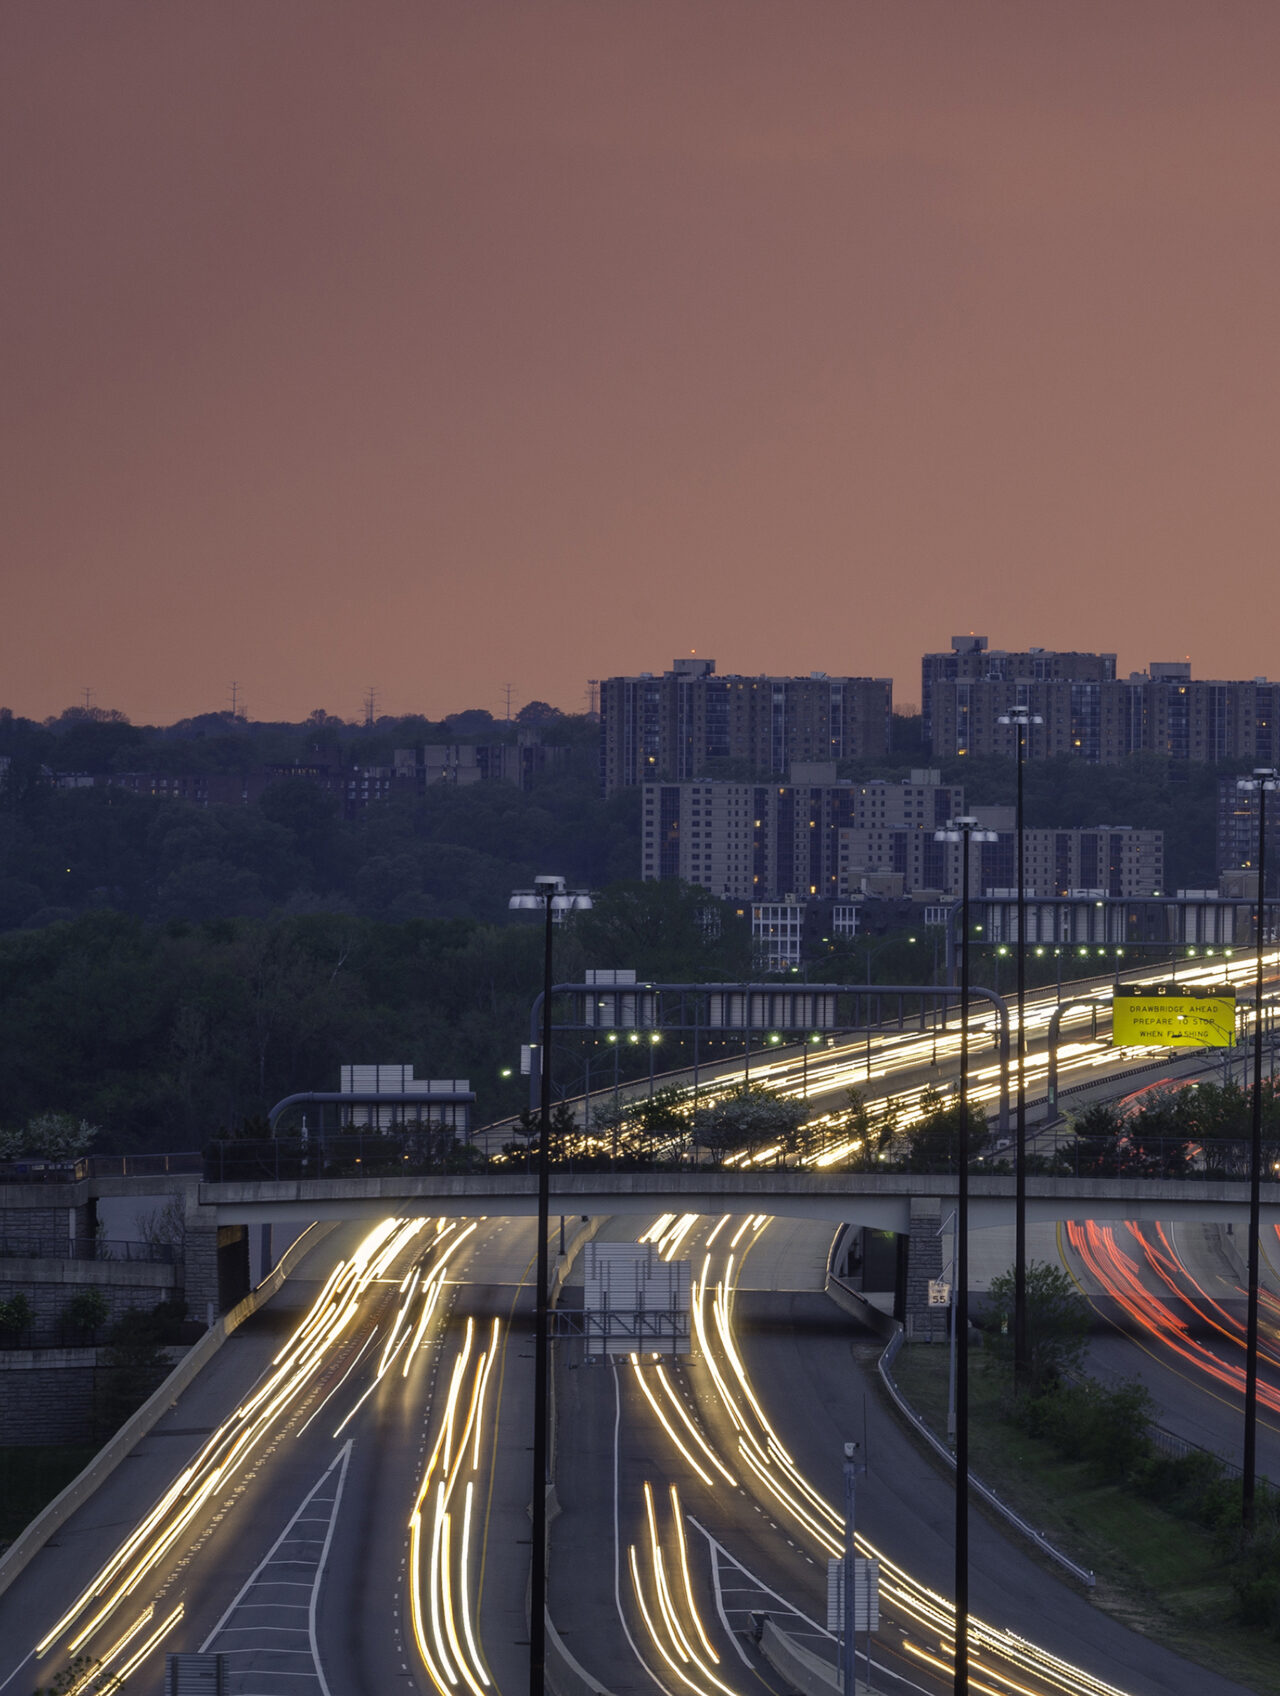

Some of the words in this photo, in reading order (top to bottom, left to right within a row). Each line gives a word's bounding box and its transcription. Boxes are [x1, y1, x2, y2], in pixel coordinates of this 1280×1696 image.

[1129, 1005, 1184, 1013] DRAWBRIDGE
[1189, 1005, 1218, 1013] AHEAD
[932, 1295, 946, 1304] 55
